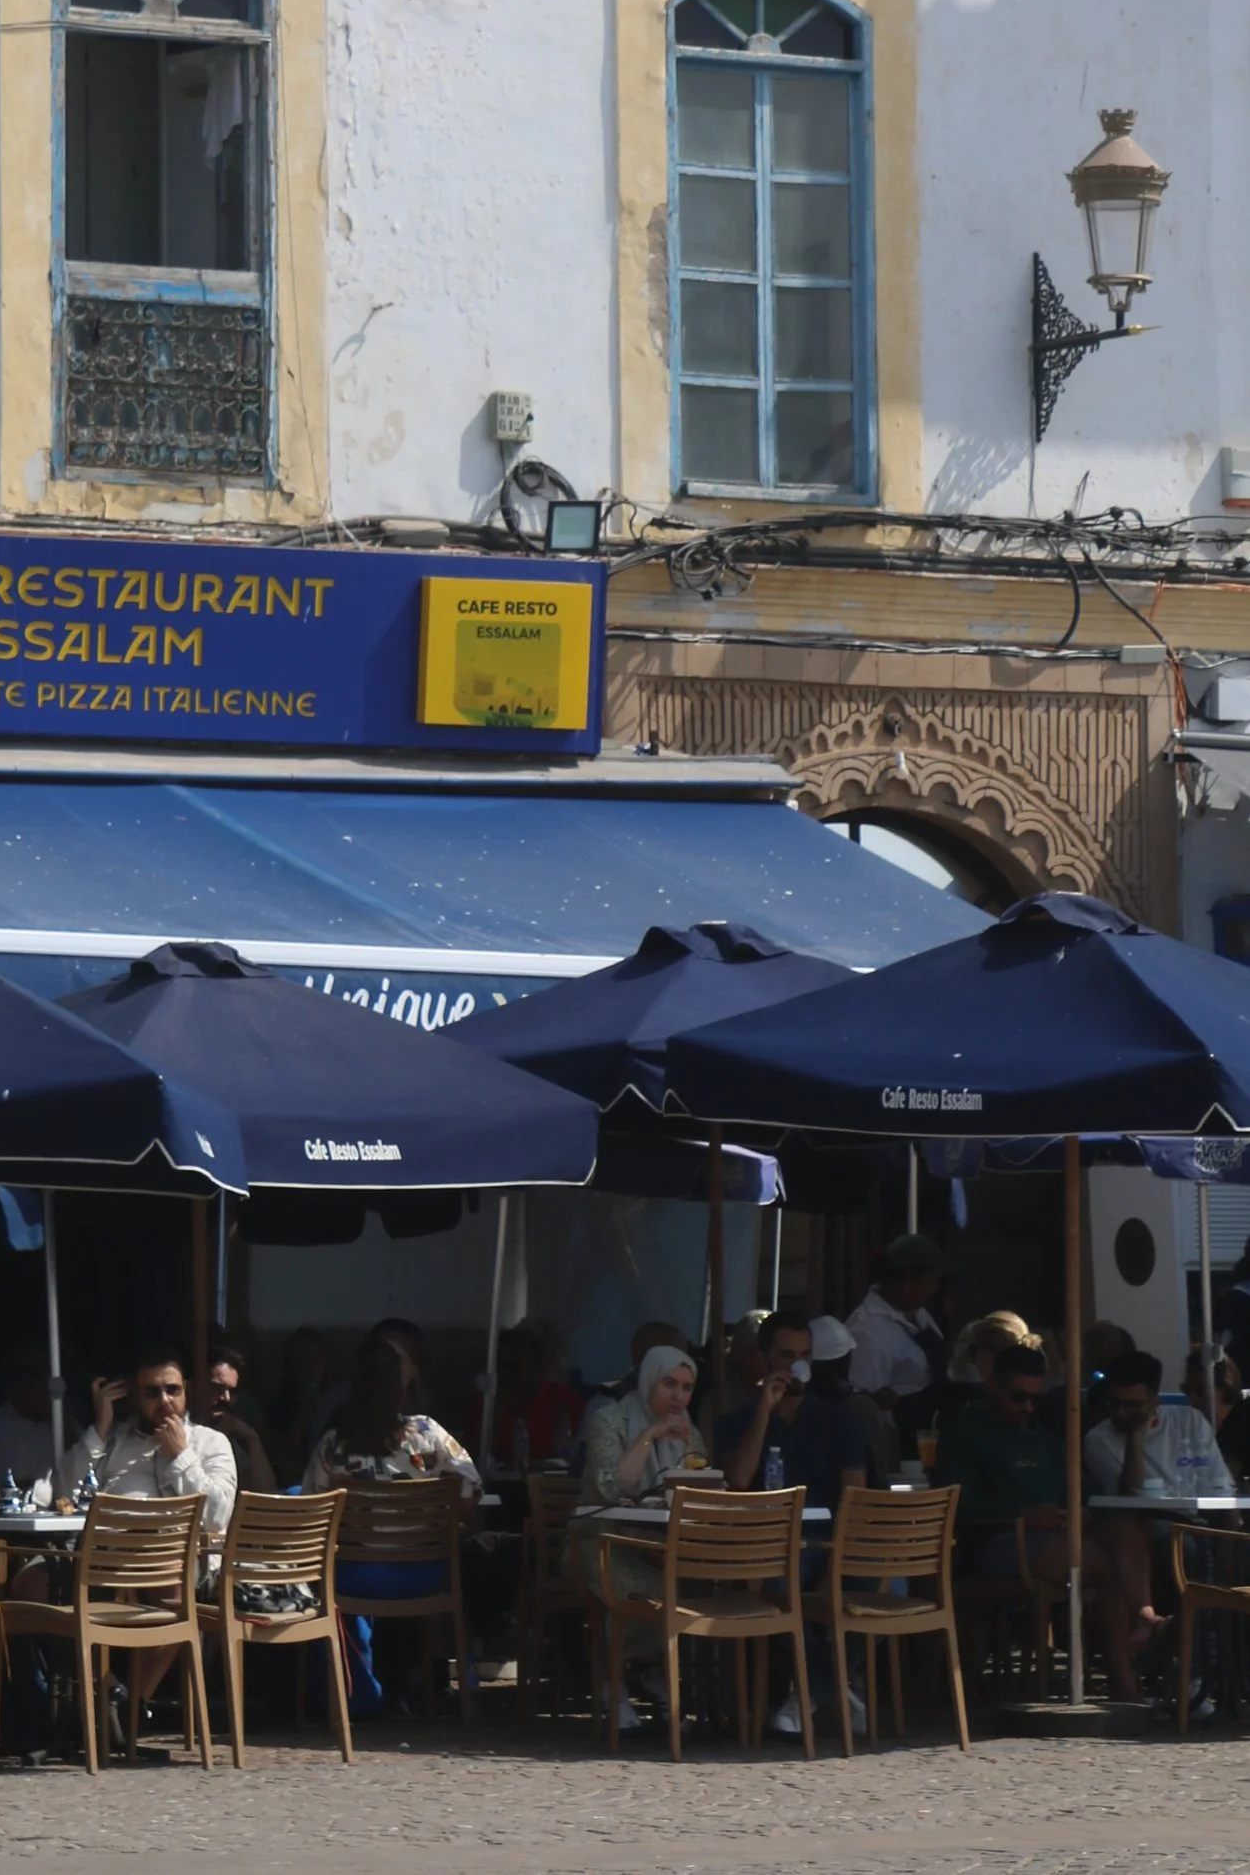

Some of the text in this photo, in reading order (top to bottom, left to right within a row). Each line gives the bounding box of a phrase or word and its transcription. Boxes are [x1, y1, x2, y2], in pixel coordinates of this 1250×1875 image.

[457, 600, 558, 616] CAFE RESTO
[475, 626, 542, 641] ESSALAM
[37, 682, 133, 712] PIZZA
[144, 686, 317, 718] ITALIENNE
[908, 1088, 940, 1110] Resto
[940, 1088, 982, 1111] Essalam
[327, 1140, 359, 1161] Resto
[357, 1139, 402, 1161] Essalam
